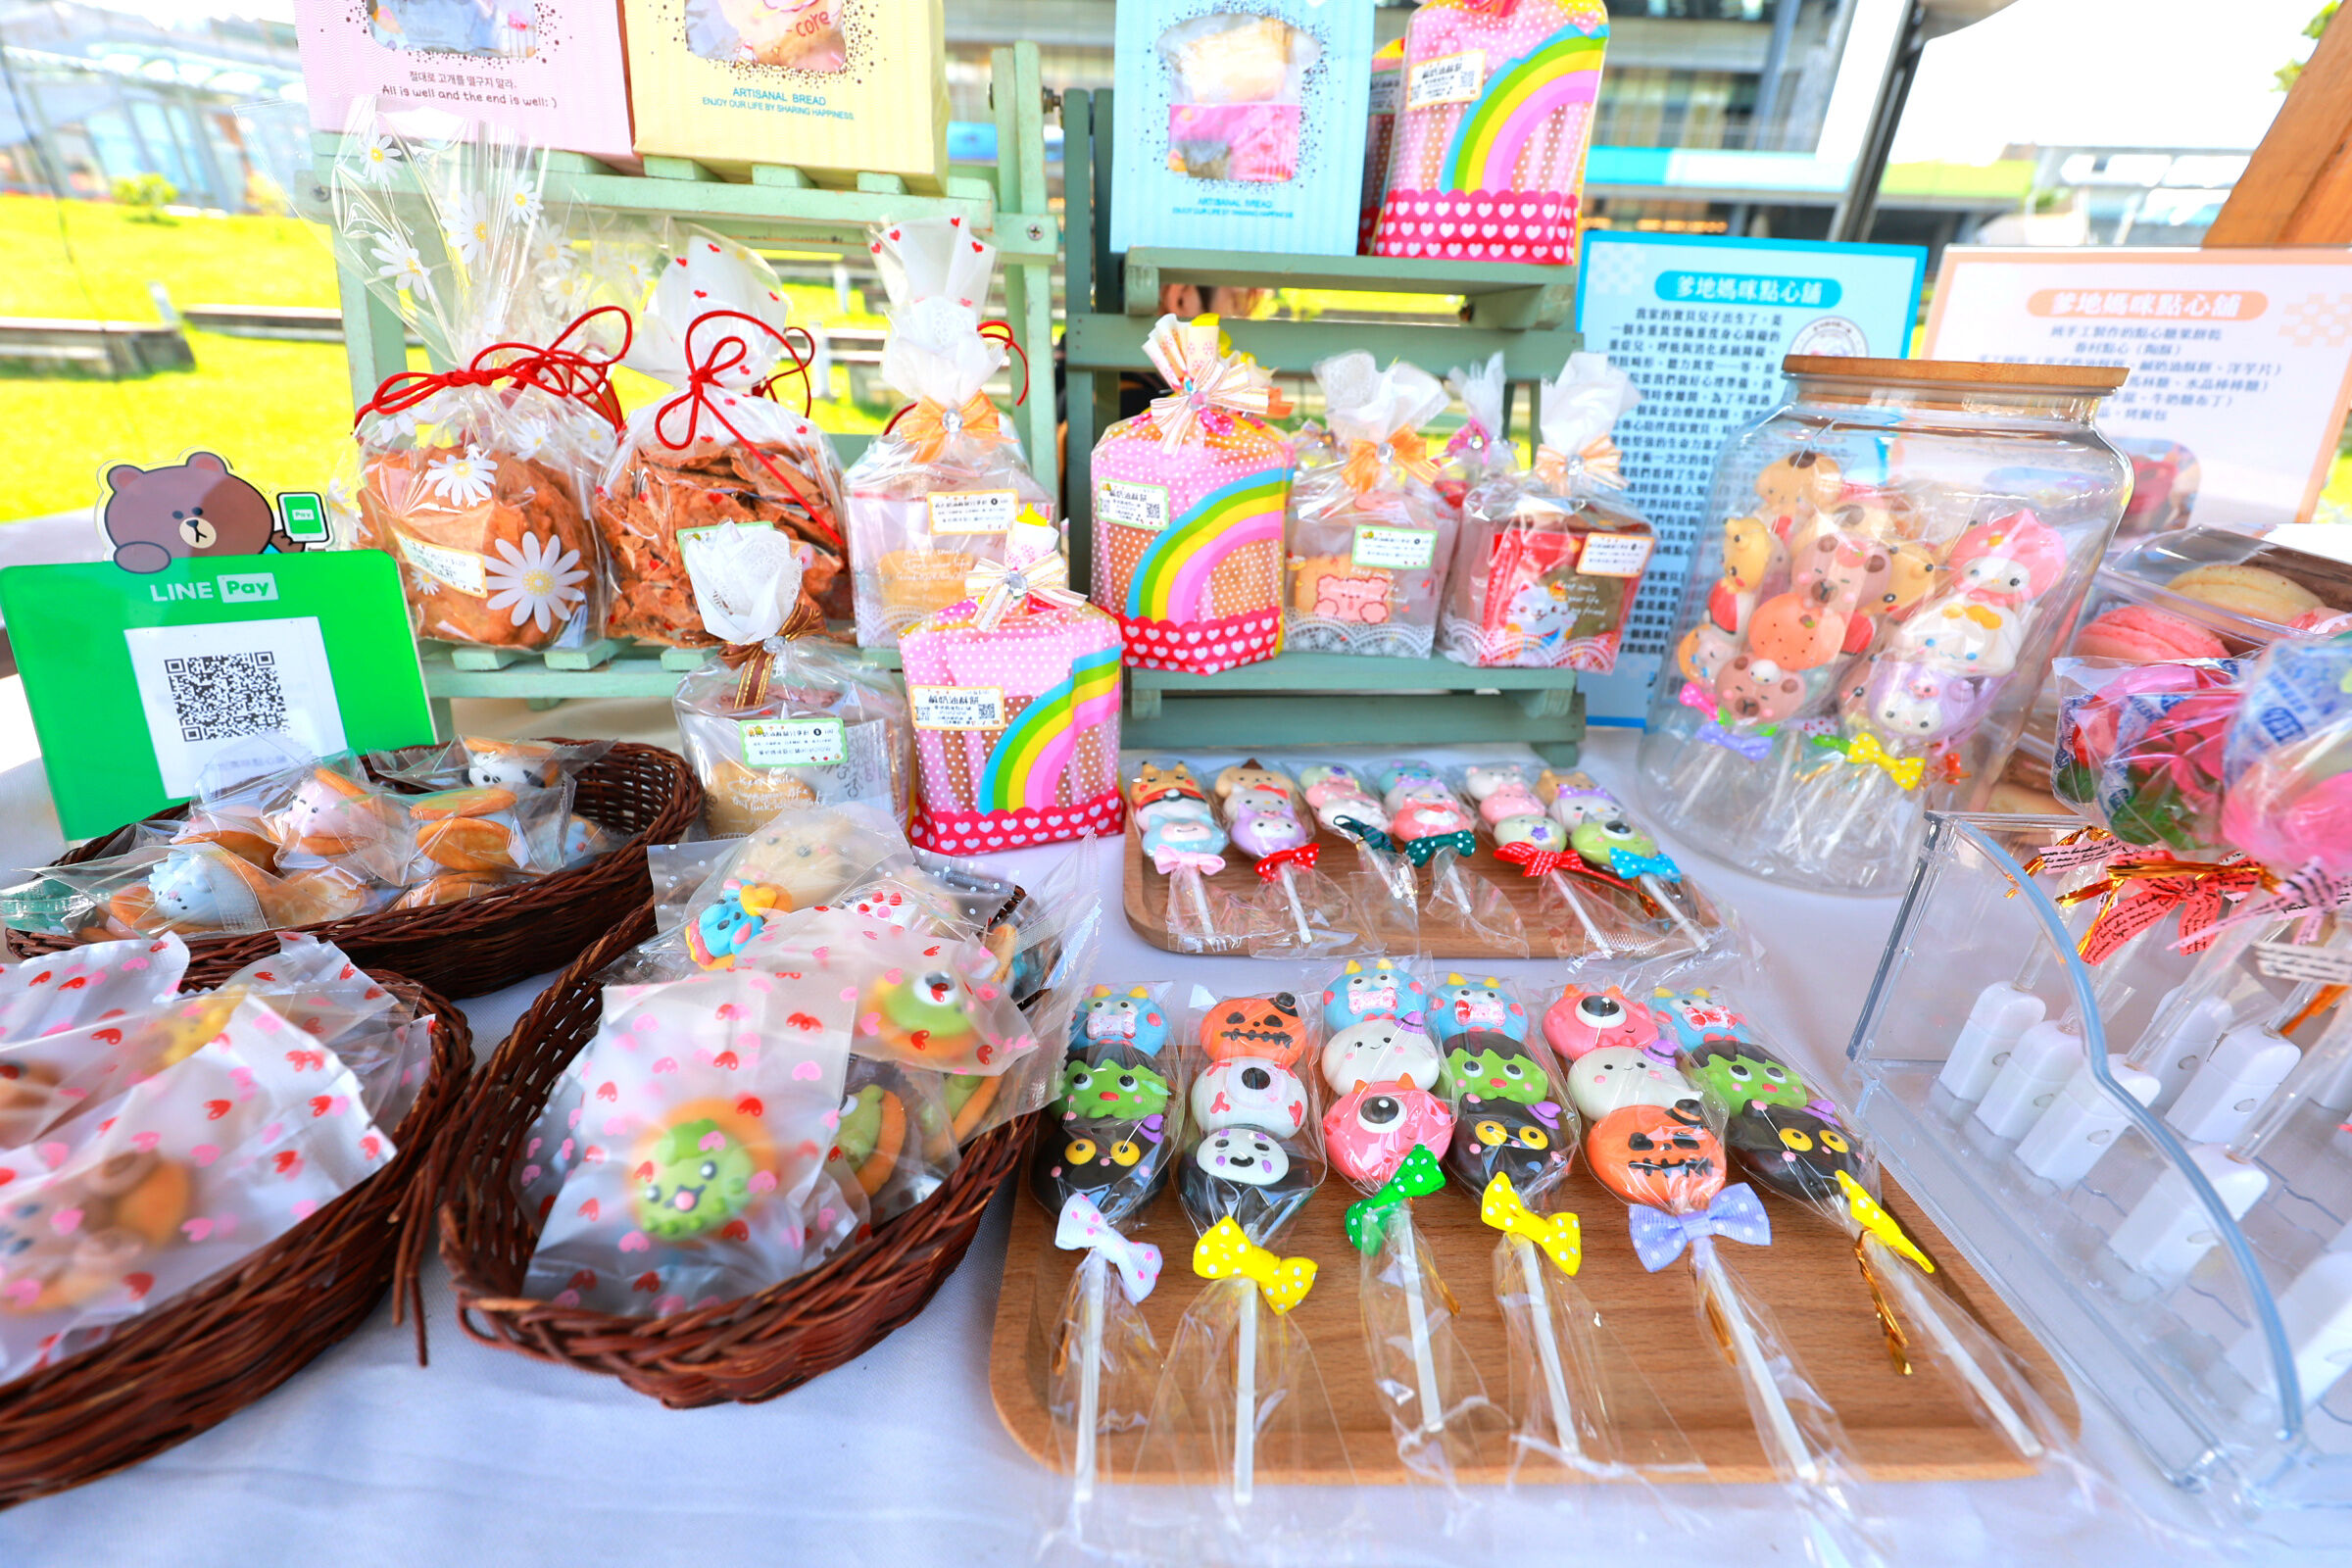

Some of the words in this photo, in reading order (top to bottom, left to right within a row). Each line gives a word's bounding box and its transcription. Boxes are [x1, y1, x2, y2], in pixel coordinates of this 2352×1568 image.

[438, 73, 466, 85] 고개를
[382, 84, 396, 95] All
[400, 86, 410, 96] is
[413, 87, 435, 98] well
[438, 89, 460, 100] and
[464, 91, 483, 102] the
[486, 93, 506, 105] end
[510, 96, 519, 106] is
[733, 87, 788, 103] ARTISANAL
[792, 93, 826, 106] BREAD
[703, 97, 727, 107] ENJOY
[729, 99, 746, 109] OUR
[748, 101, 763, 111] LIFE
[764, 103, 774, 112] BY
[777, 104, 810, 116] SHARING
[149, 581, 215, 602] LINE
[225, 580, 270, 597] Pay
